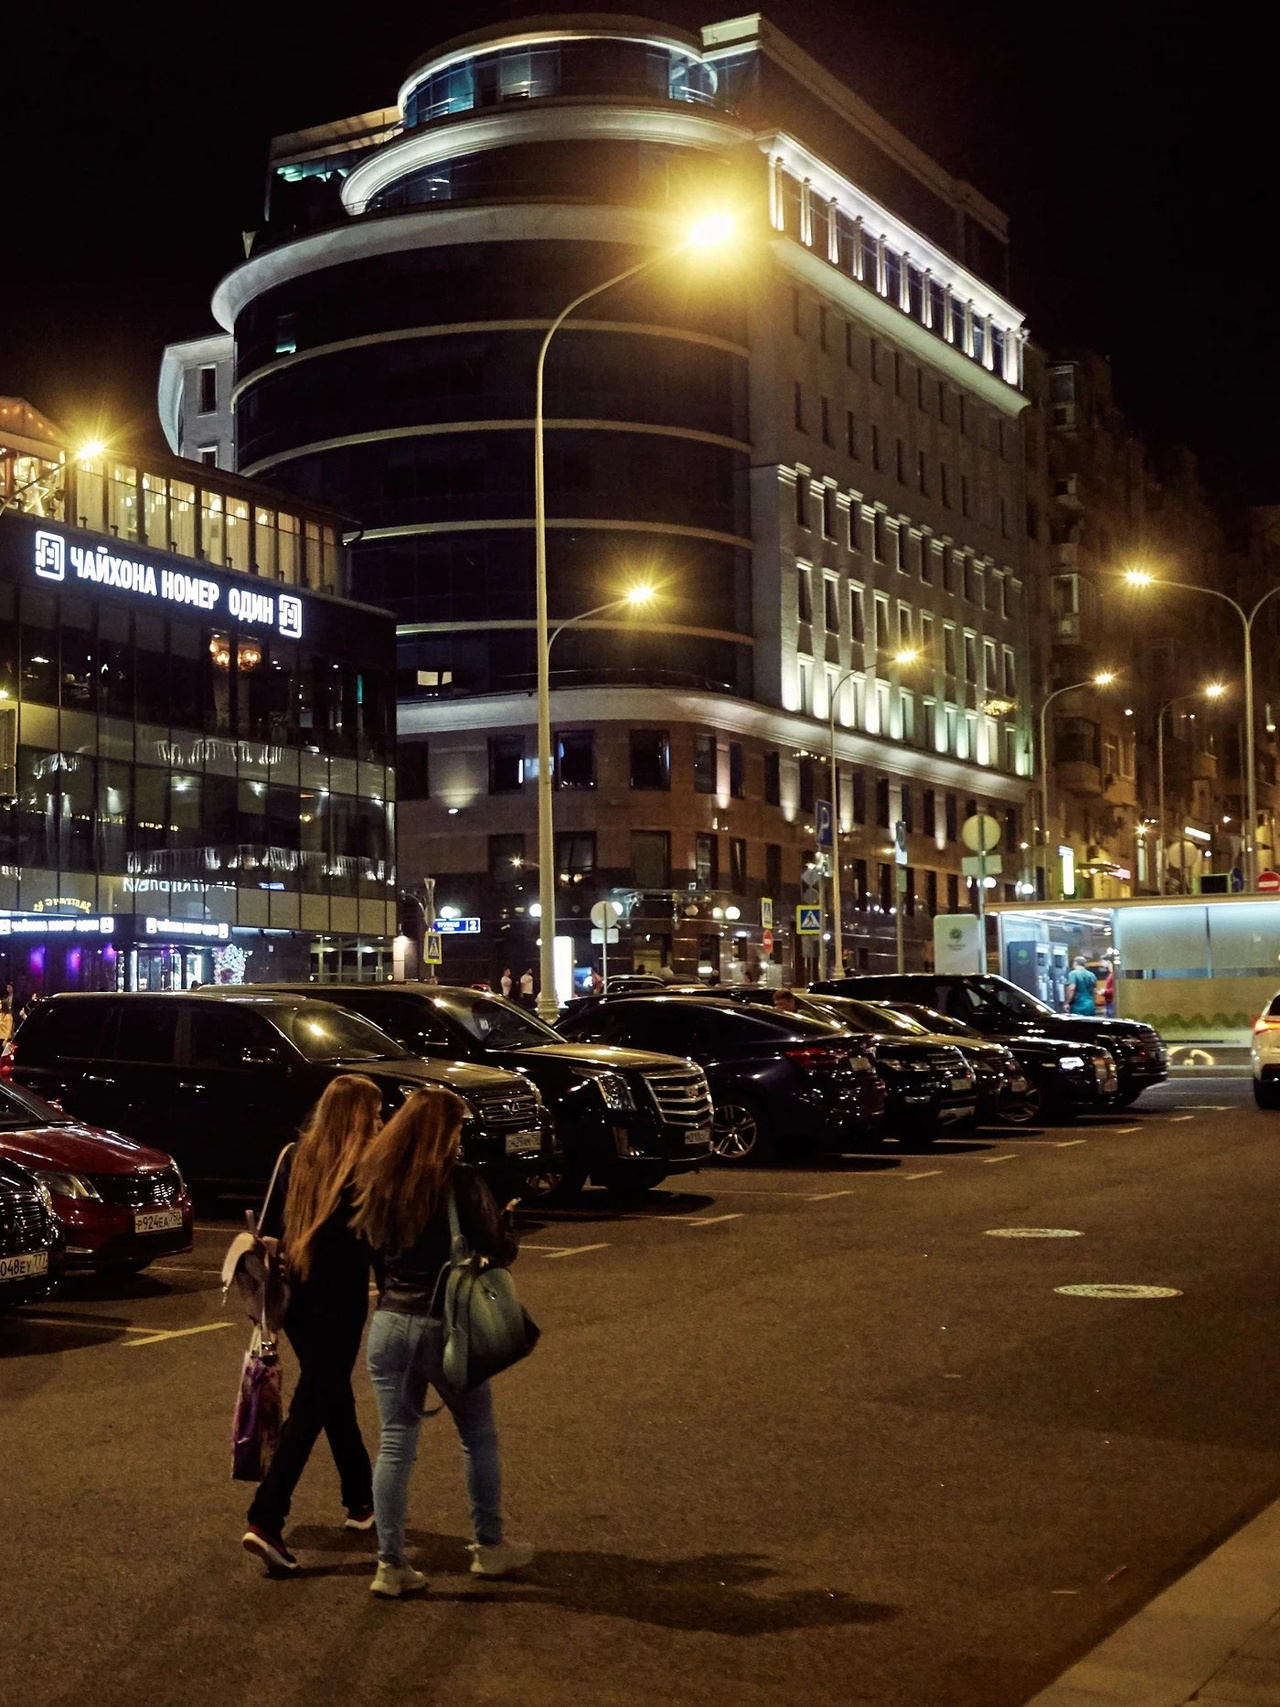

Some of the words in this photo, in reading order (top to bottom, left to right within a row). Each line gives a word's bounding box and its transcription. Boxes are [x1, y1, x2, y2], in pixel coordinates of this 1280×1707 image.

[70, 546, 157, 596] ЧАЙХОНА
[161, 571, 220, 610] НОМЕР
[228, 588, 274, 624] ОДИН
[469, 920, 478, 931] 2
